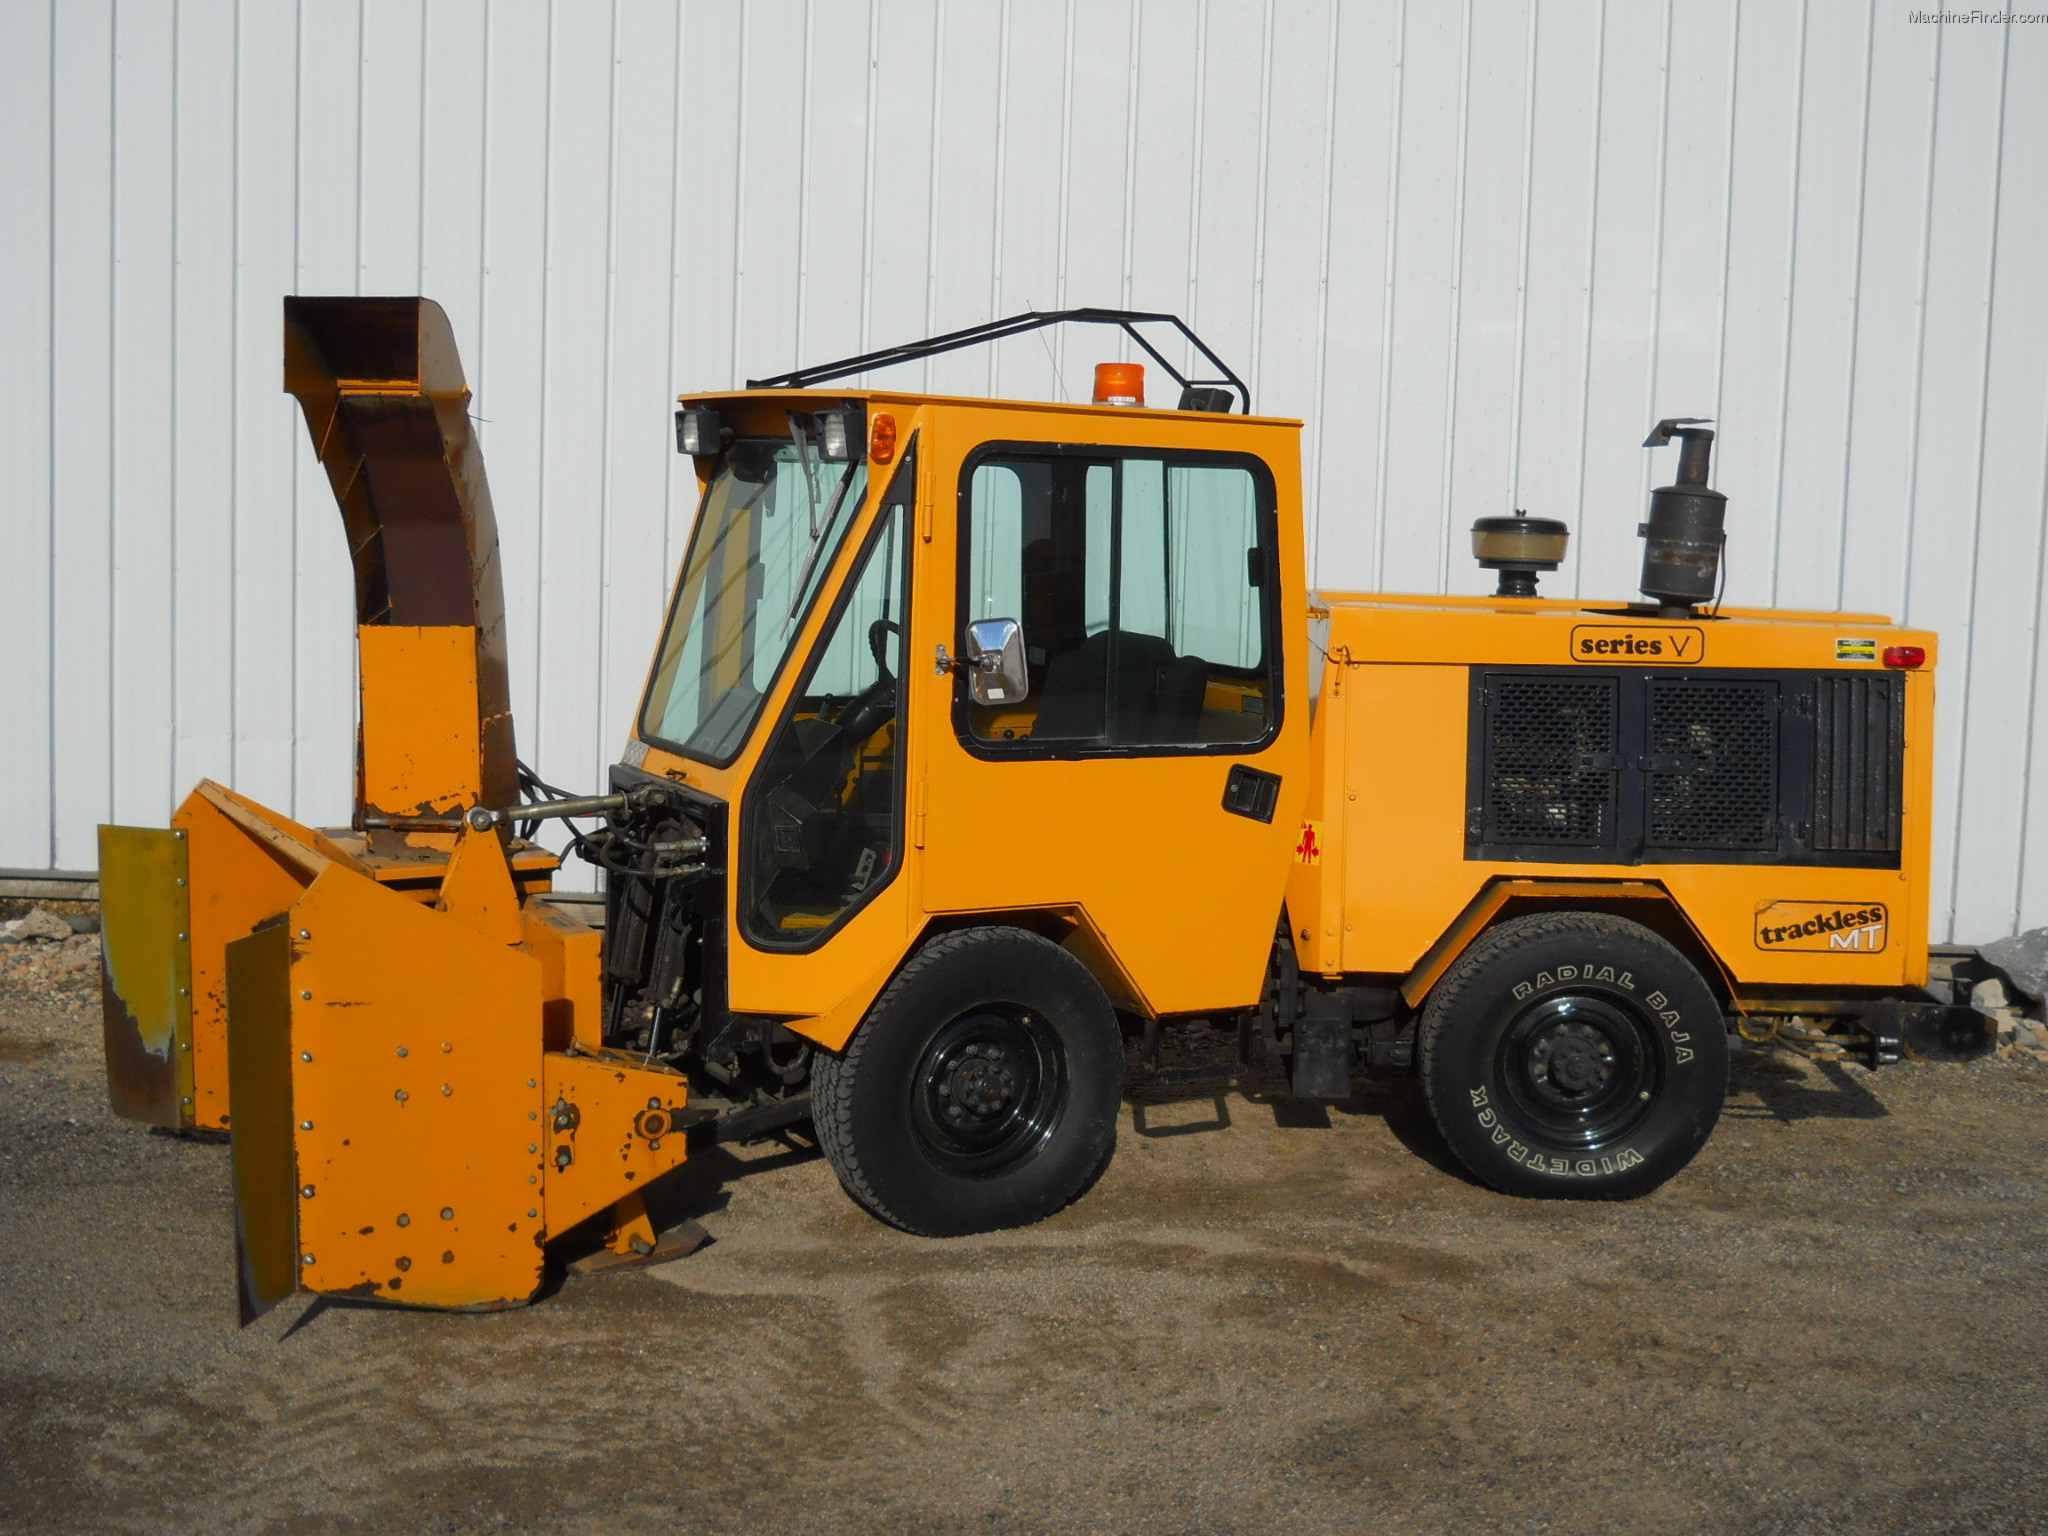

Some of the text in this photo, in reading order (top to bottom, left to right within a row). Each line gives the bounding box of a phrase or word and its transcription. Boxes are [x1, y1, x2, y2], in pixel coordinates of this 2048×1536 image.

[1580, 634, 1691, 657] series V
[1760, 907, 1883, 944] trackless
[1829, 924, 1883, 949] MT
[1512, 964, 1694, 1065] RADIAL BAJA
[1470, 1085, 1645, 1176] WIDETRACK
